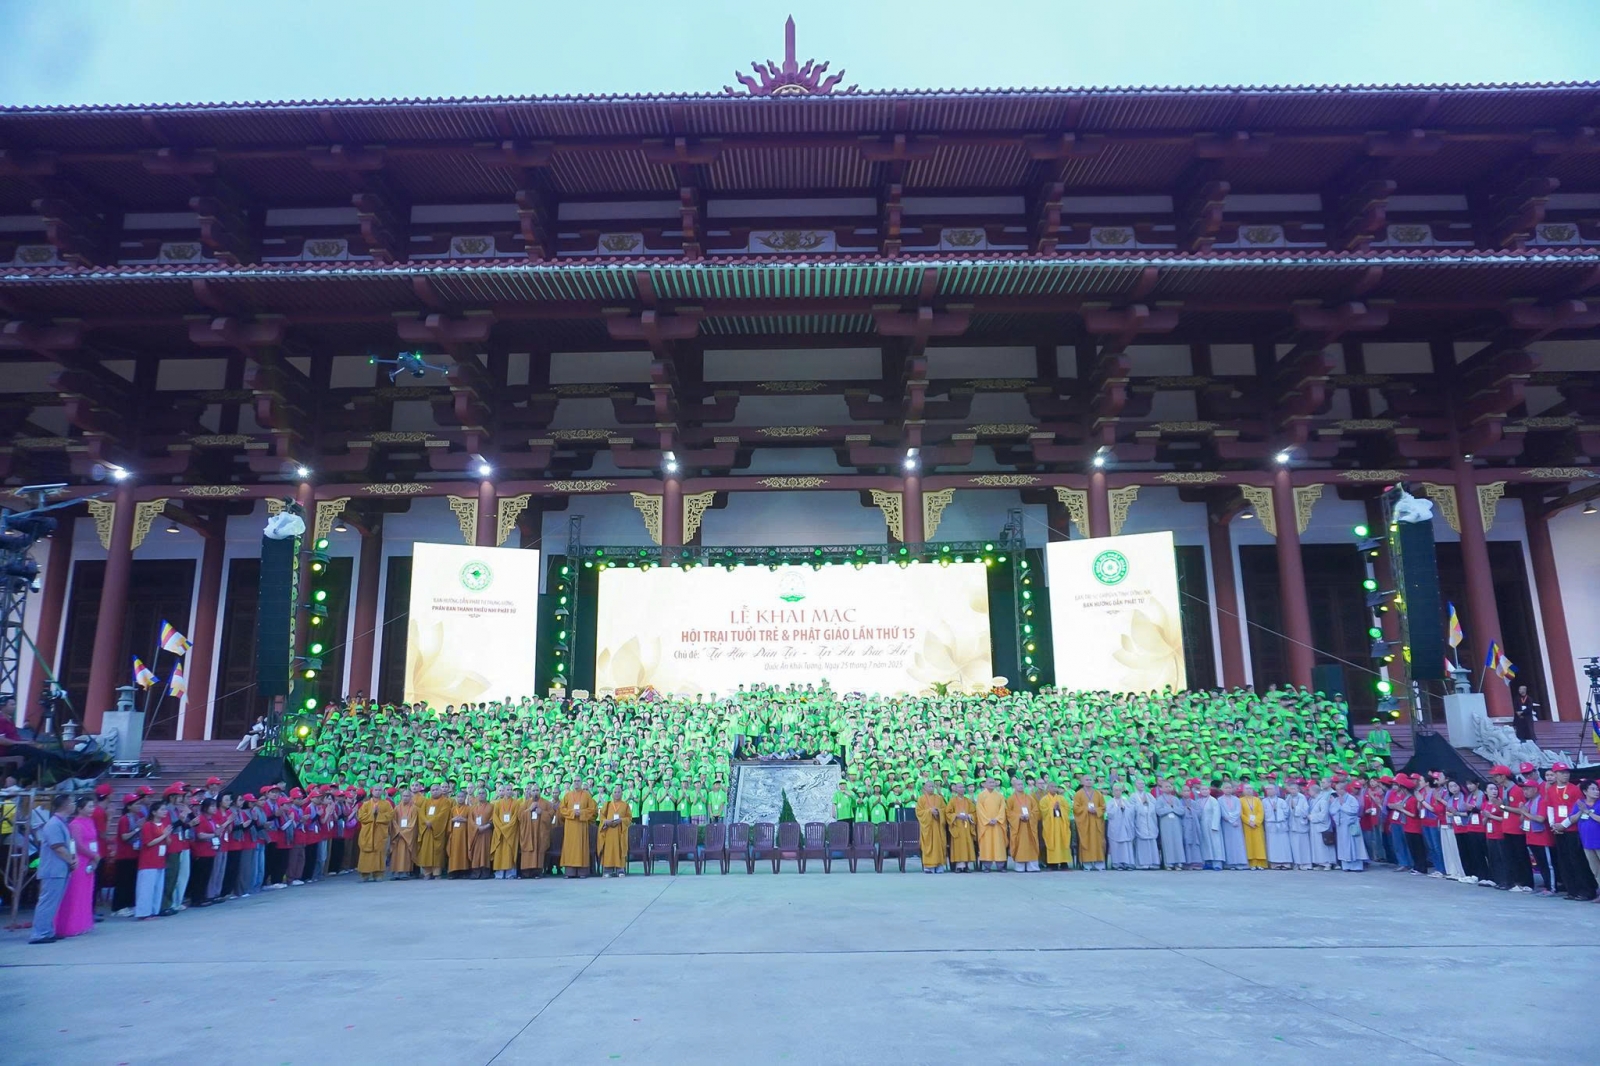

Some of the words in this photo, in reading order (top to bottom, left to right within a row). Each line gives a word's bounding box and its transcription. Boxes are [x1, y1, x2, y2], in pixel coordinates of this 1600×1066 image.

[731, 604, 751, 625] LỄ
[756, 609, 805, 625] KHAI
[812, 608, 857, 626] MẠC
[681, 628, 701, 646] HỘI
[703, 630, 728, 645] TRẠI
[730, 626, 756, 642] TUỔI
[758, 626, 779, 642] TRẺ
[781, 629, 791, 642] &
[793, 627, 821, 645] PHẬT
[823, 627, 849, 641] GIÁO
[852, 625, 874, 641] LẦN
[876, 625, 899, 641] THỨ
[902, 627, 915, 640] 15
[673, 650, 688, 660] Chủ
[825, 661, 840, 672] Ngày
[841, 661, 849, 669] 25
[850, 661, 868, 671] tháng
[873, 661, 887, 669] năm
[888, 660, 903, 669] 2025
